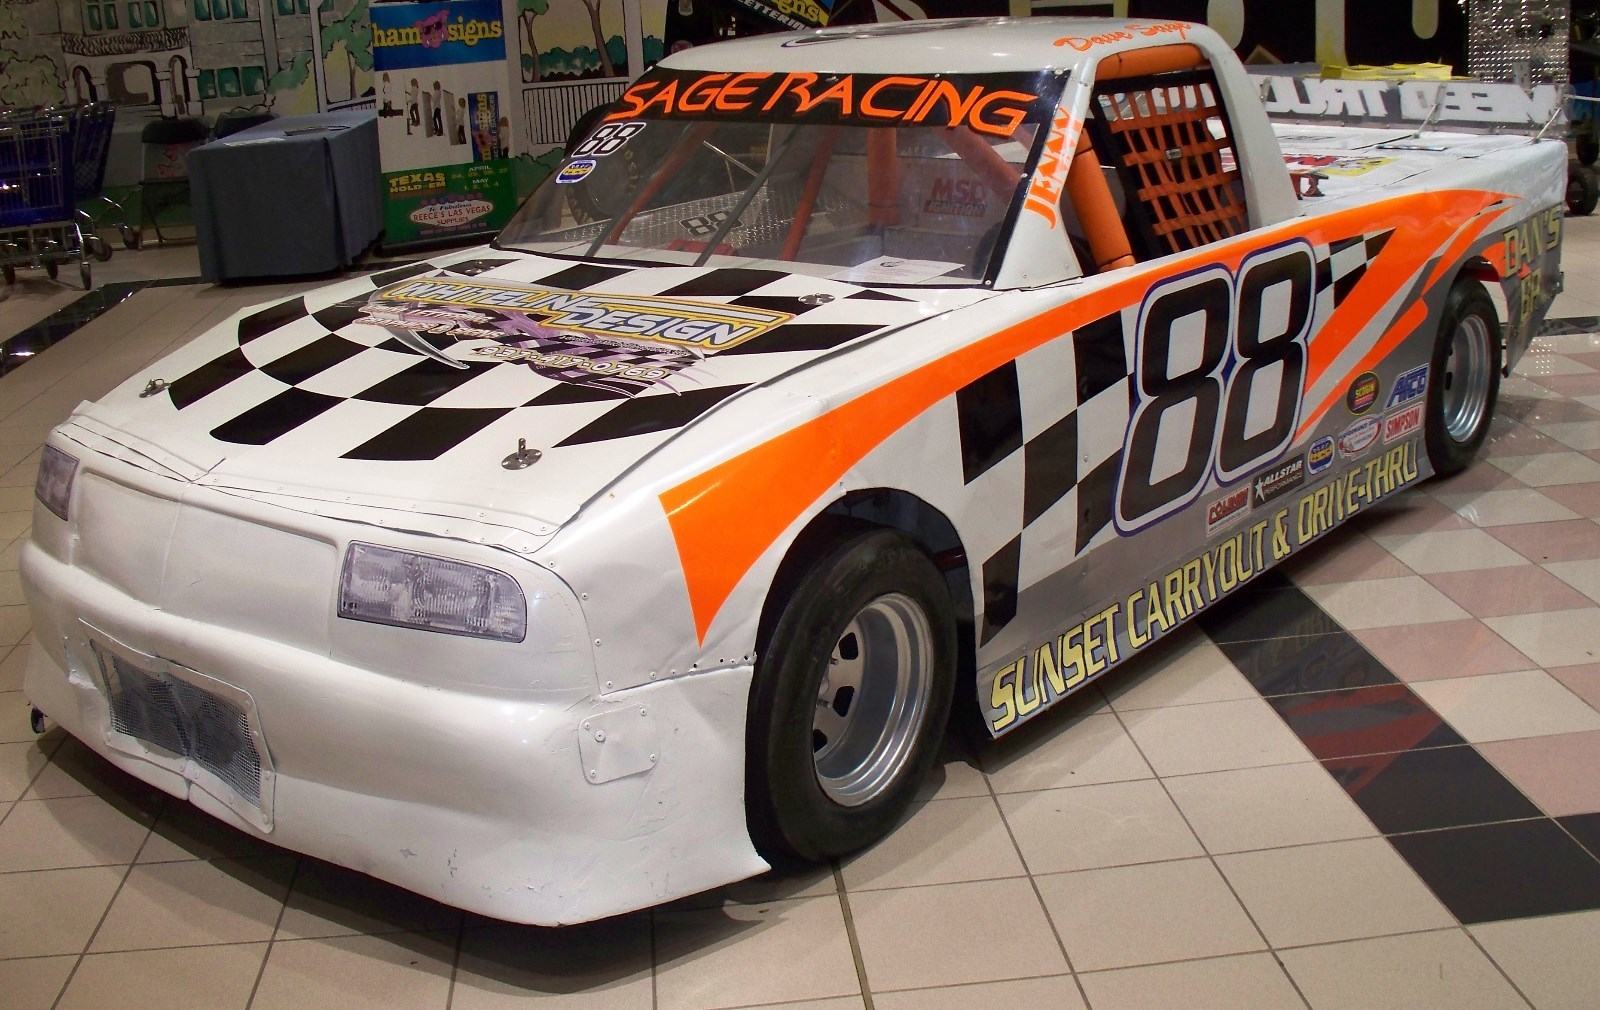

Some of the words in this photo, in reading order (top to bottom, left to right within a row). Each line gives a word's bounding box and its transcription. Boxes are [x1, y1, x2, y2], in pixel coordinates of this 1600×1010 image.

[371, 23, 422, 47] ham
[447, 16, 502, 46] signs
[602, 73, 775, 121] SAGE
[761, 72, 1039, 136] RACING
[491, 129, 499, 160] ACTABLE
[571, 122, 647, 157] 88
[388, 172, 446, 187] TEXAS
[413, 210, 446, 221] REECE'S
[448, 208, 463, 217] LAS
[466, 204, 492, 214] VEGAS
[437, 216, 469, 225] SUPPLIES
[1503, 204, 1563, 278] DAN'S
[550, 306, 755, 347] DESIGN
[1113, 238, 1315, 535] 88
[1386, 408, 1420, 439] SIMPSON
[1263, 459, 1303, 487] ALLSTAR
[990, 602, 1122, 733] SUNSET
[1127, 518, 1269, 650] CARRYOUT
[1272, 507, 1292, 560] &
[1297, 434, 1420, 546] DRIVE-THRU
